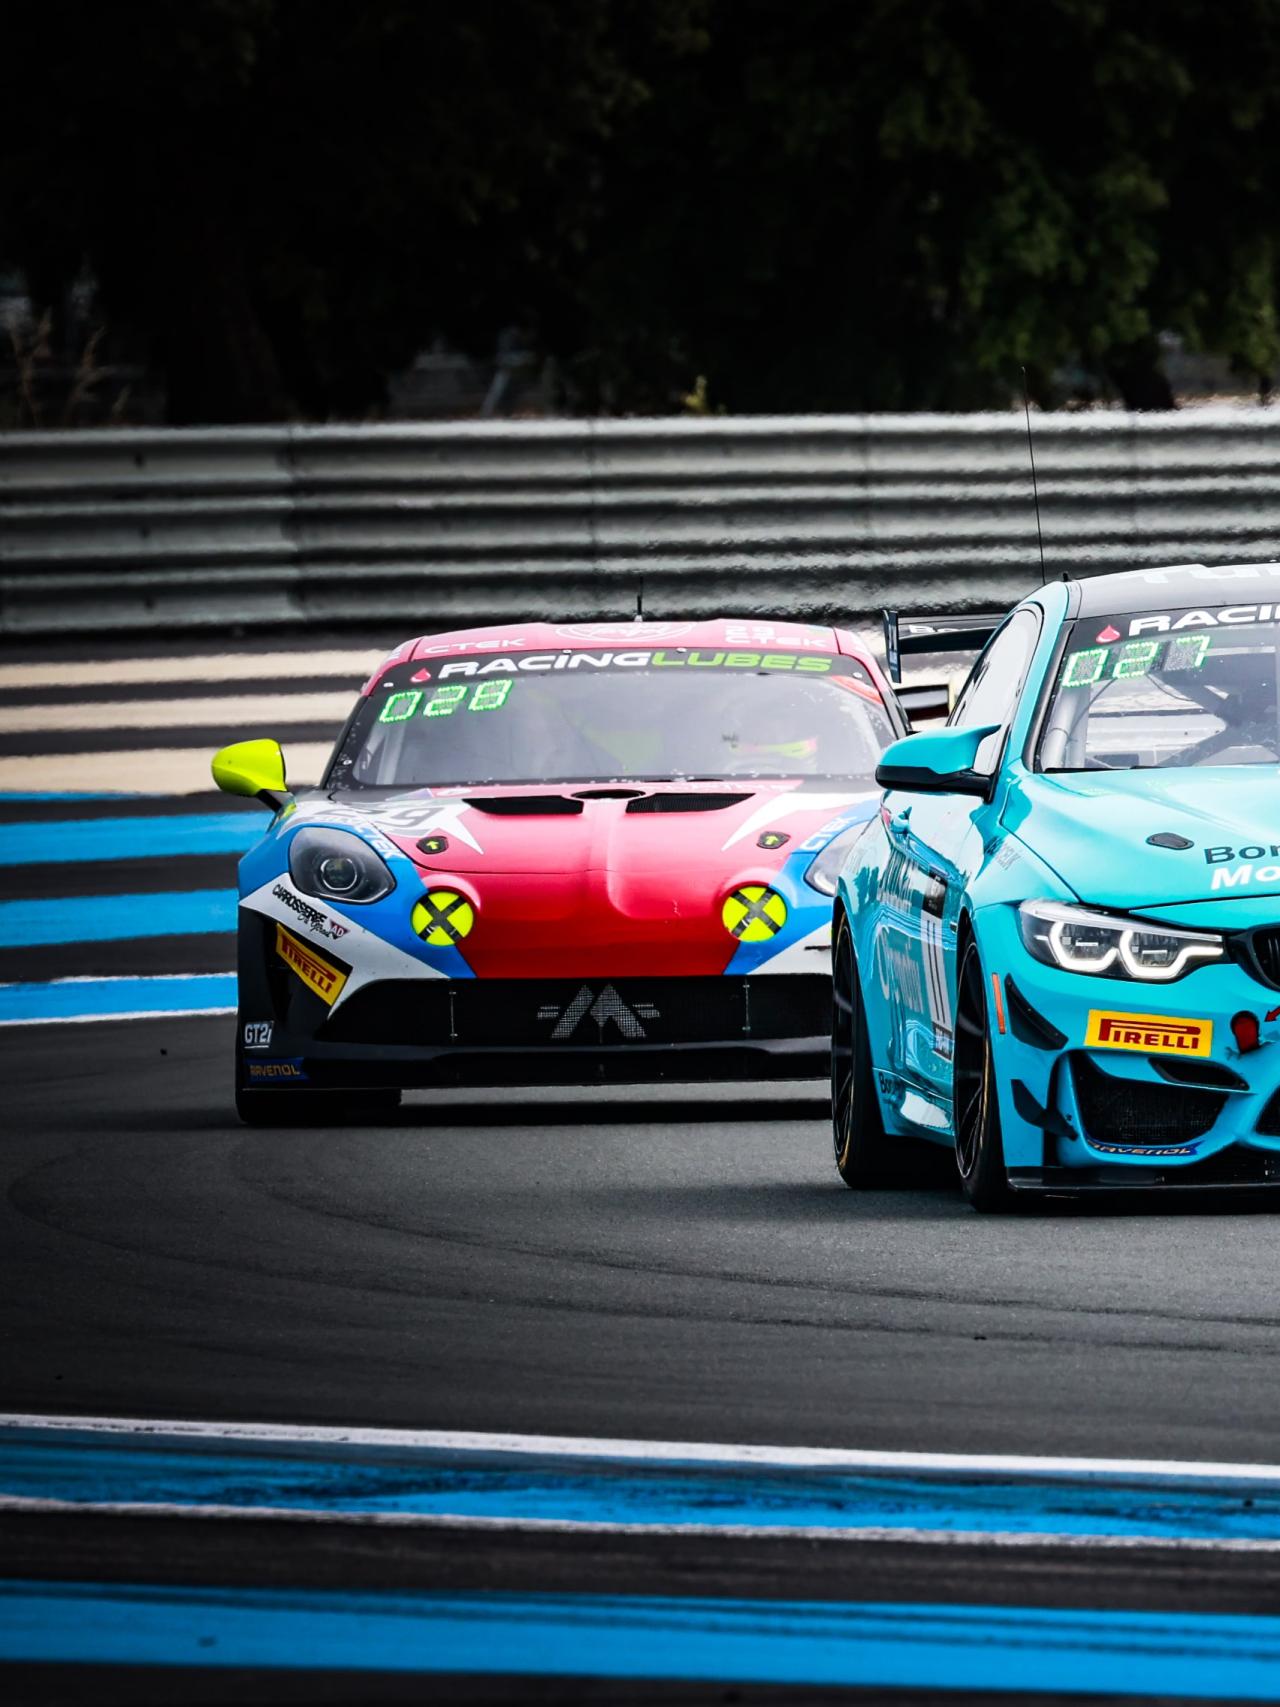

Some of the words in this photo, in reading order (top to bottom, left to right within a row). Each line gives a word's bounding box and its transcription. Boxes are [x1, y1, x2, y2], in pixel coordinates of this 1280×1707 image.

[425, 638, 526, 654] CTEK
[725, 636, 828, 648] CTEK
[1062, 635, 1211, 687] 027
[379, 680, 513, 722] 028
[331, 924, 345, 937] AD
[281, 933, 338, 994] PIRELLI
[1098, 1018, 1201, 1049] PIRELLI
